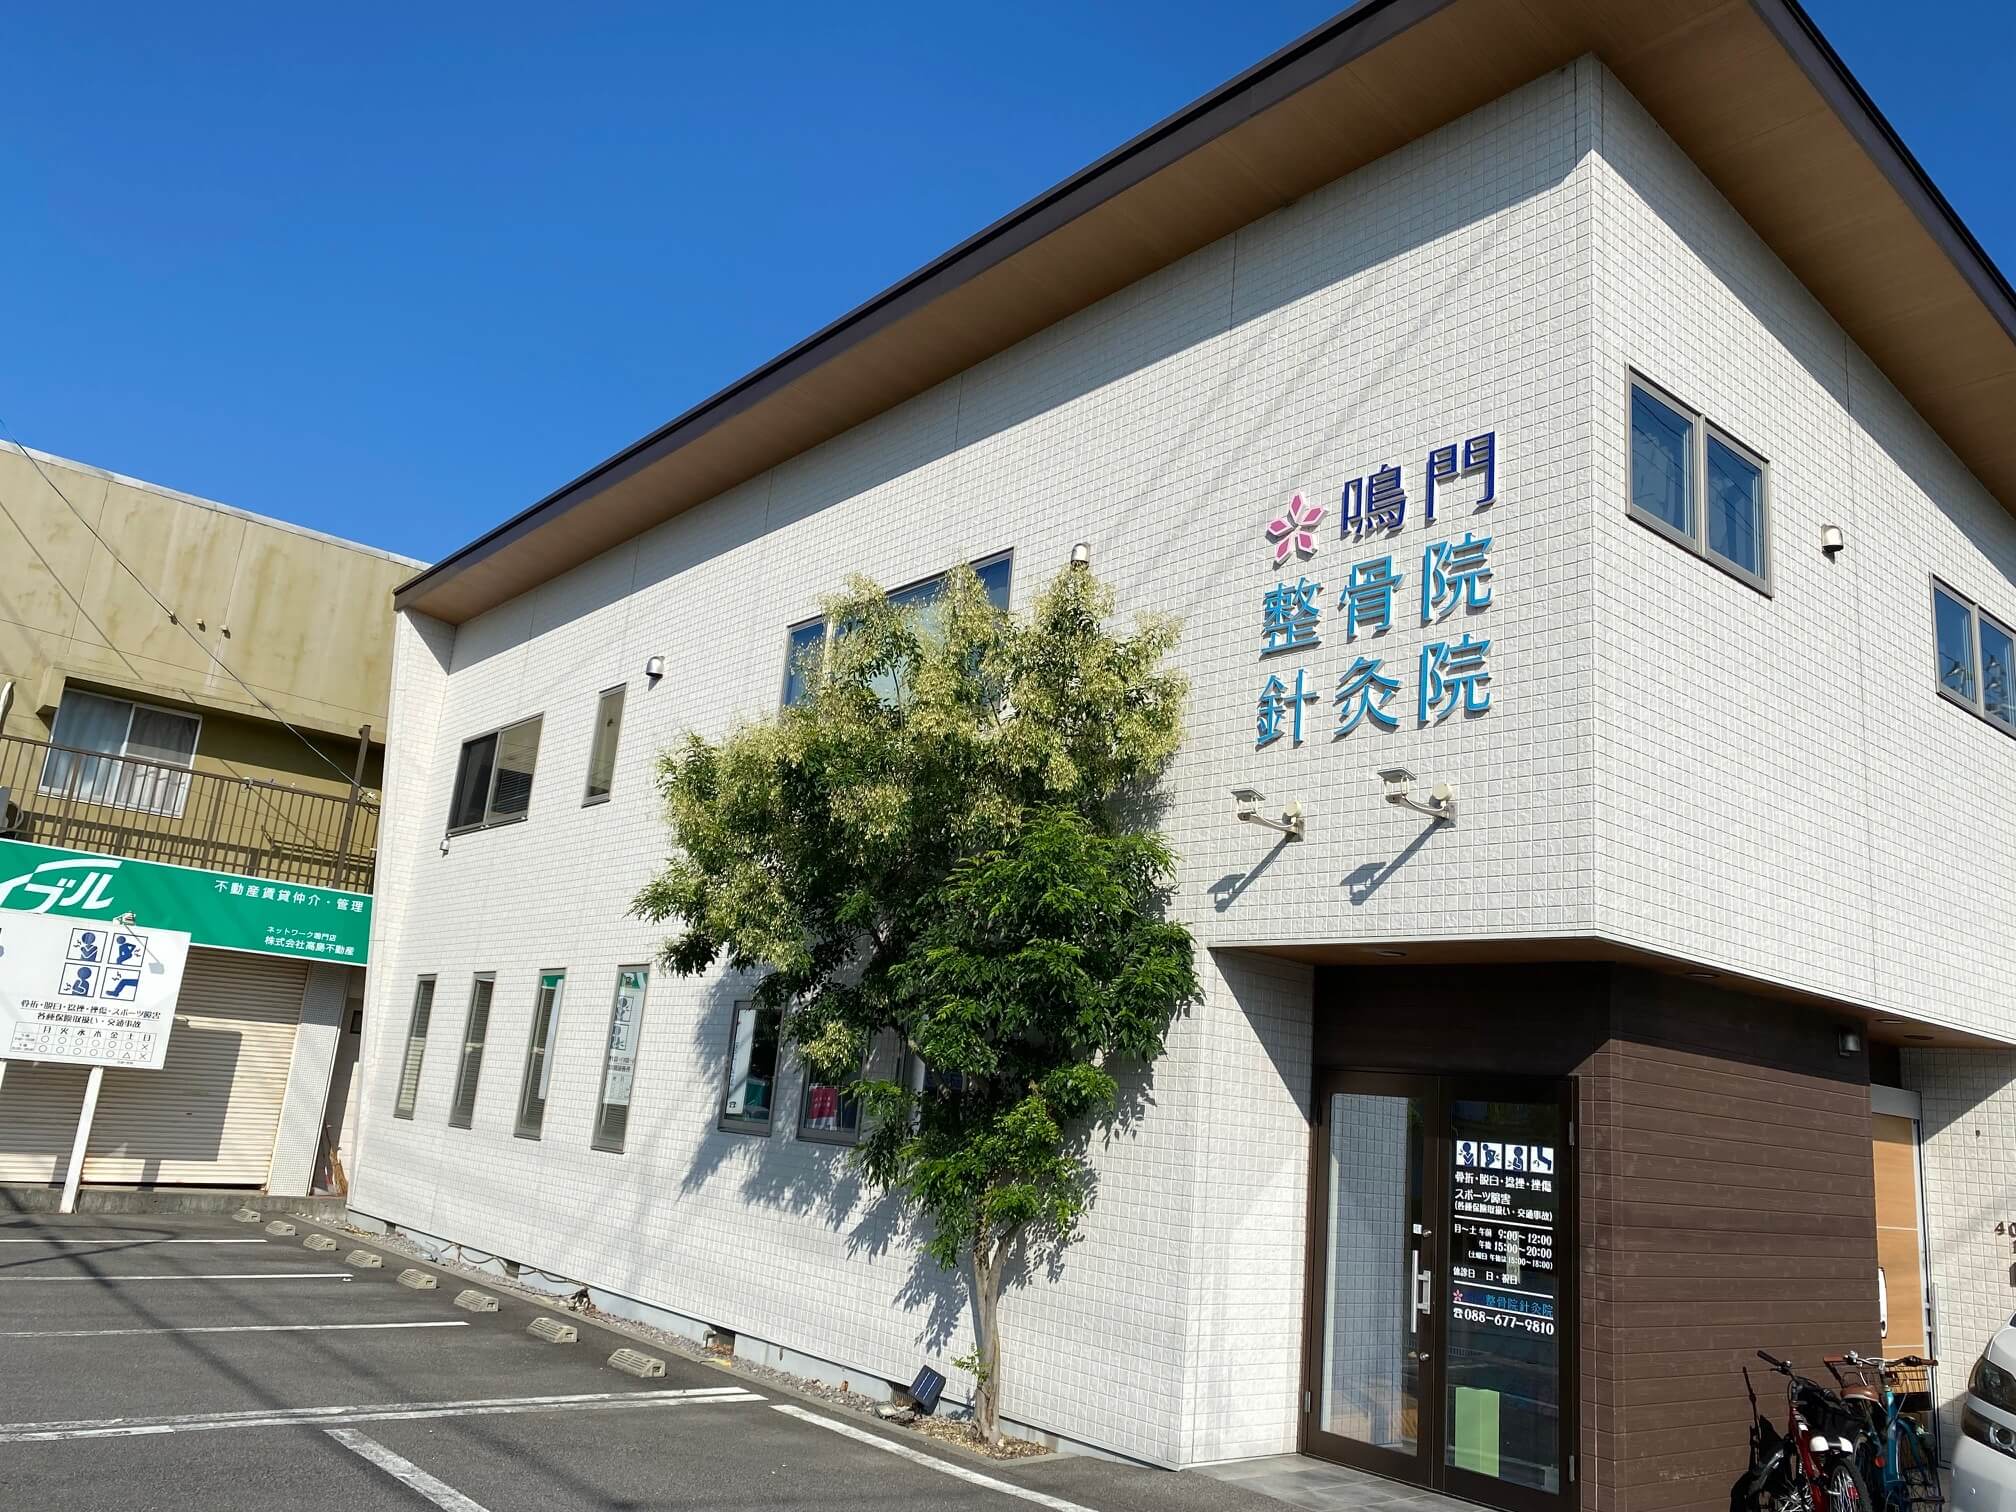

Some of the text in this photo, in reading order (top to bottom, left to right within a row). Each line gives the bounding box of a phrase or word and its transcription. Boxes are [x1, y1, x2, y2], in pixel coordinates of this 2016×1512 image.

[1342, 431, 1496, 536] 鳴門
[1260, 532, 1494, 657] 整骨院
[1256, 633, 1493, 746] 針灸院
[1454, 1188, 1511, 1205] スポーツ障害
